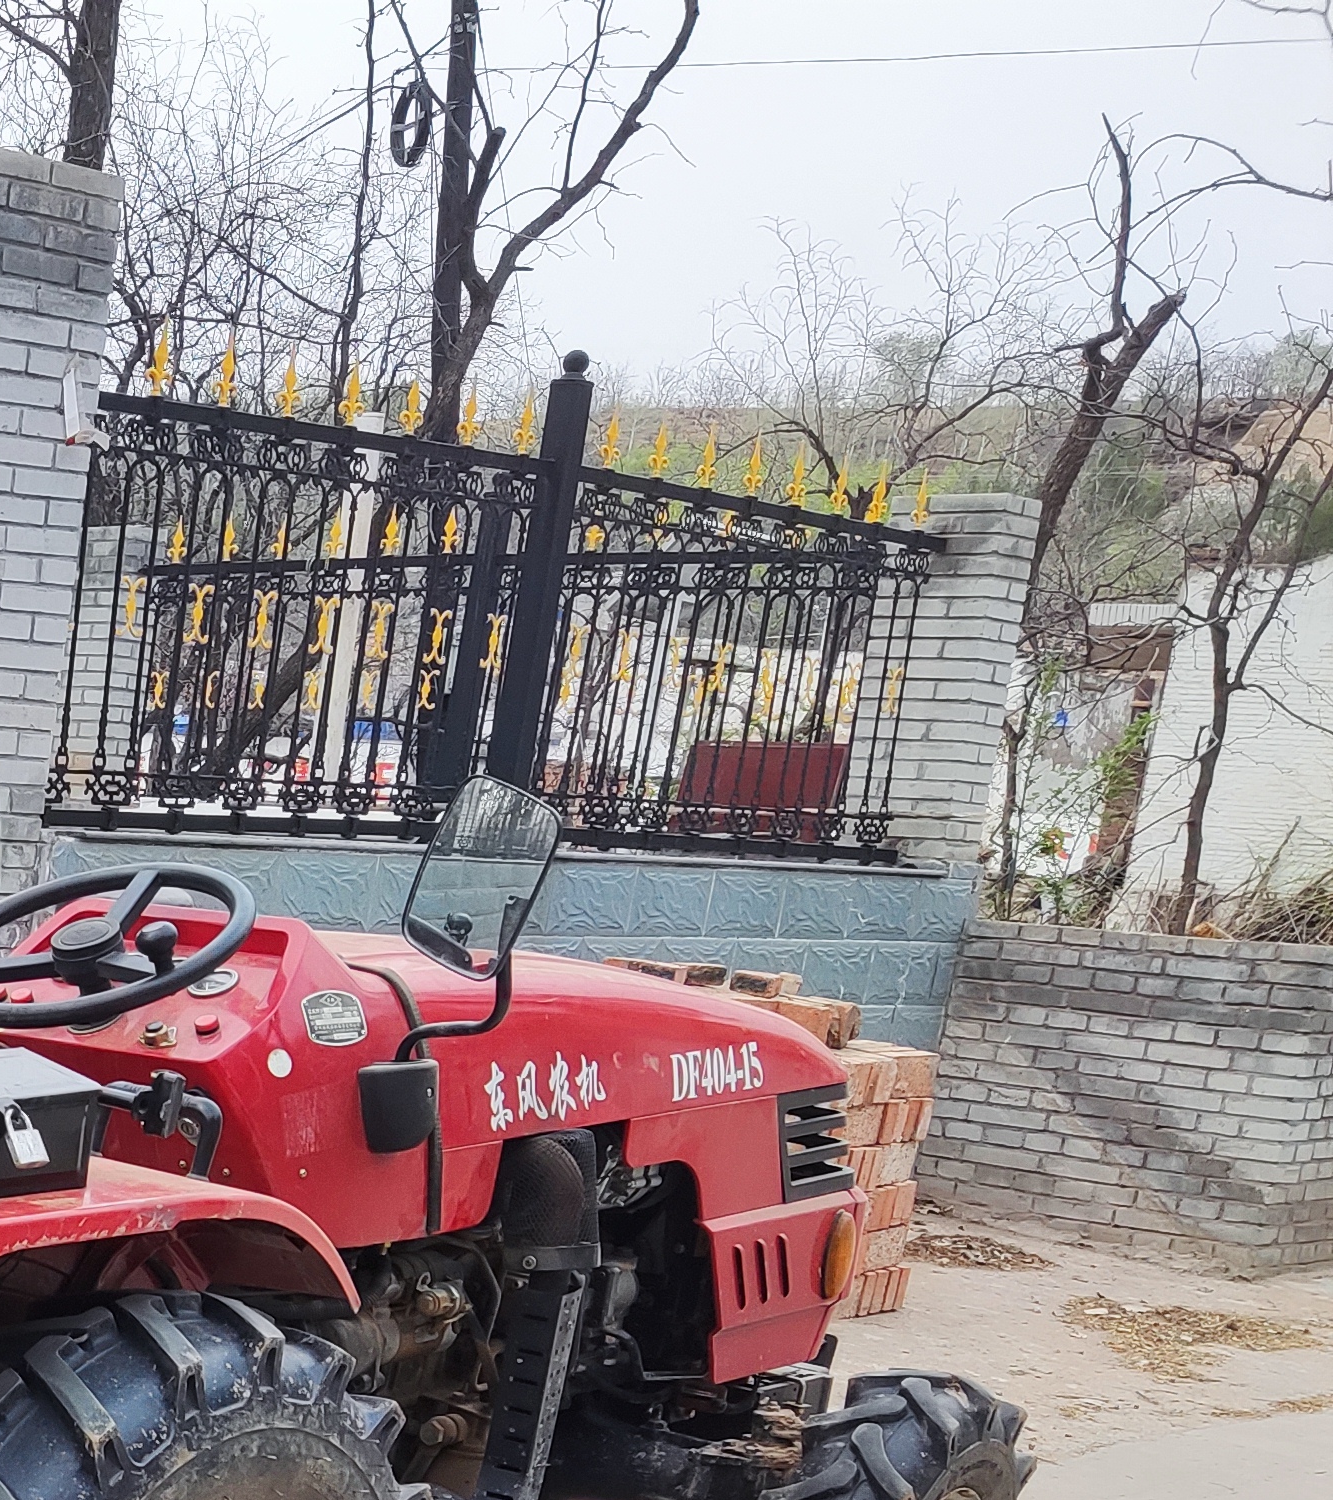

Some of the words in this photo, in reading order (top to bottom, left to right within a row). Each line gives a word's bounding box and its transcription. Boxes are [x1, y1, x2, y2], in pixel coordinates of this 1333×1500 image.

[484, 1051, 607, 1132] 东风农机
[670, 1041, 764, 1103] DF404-15
